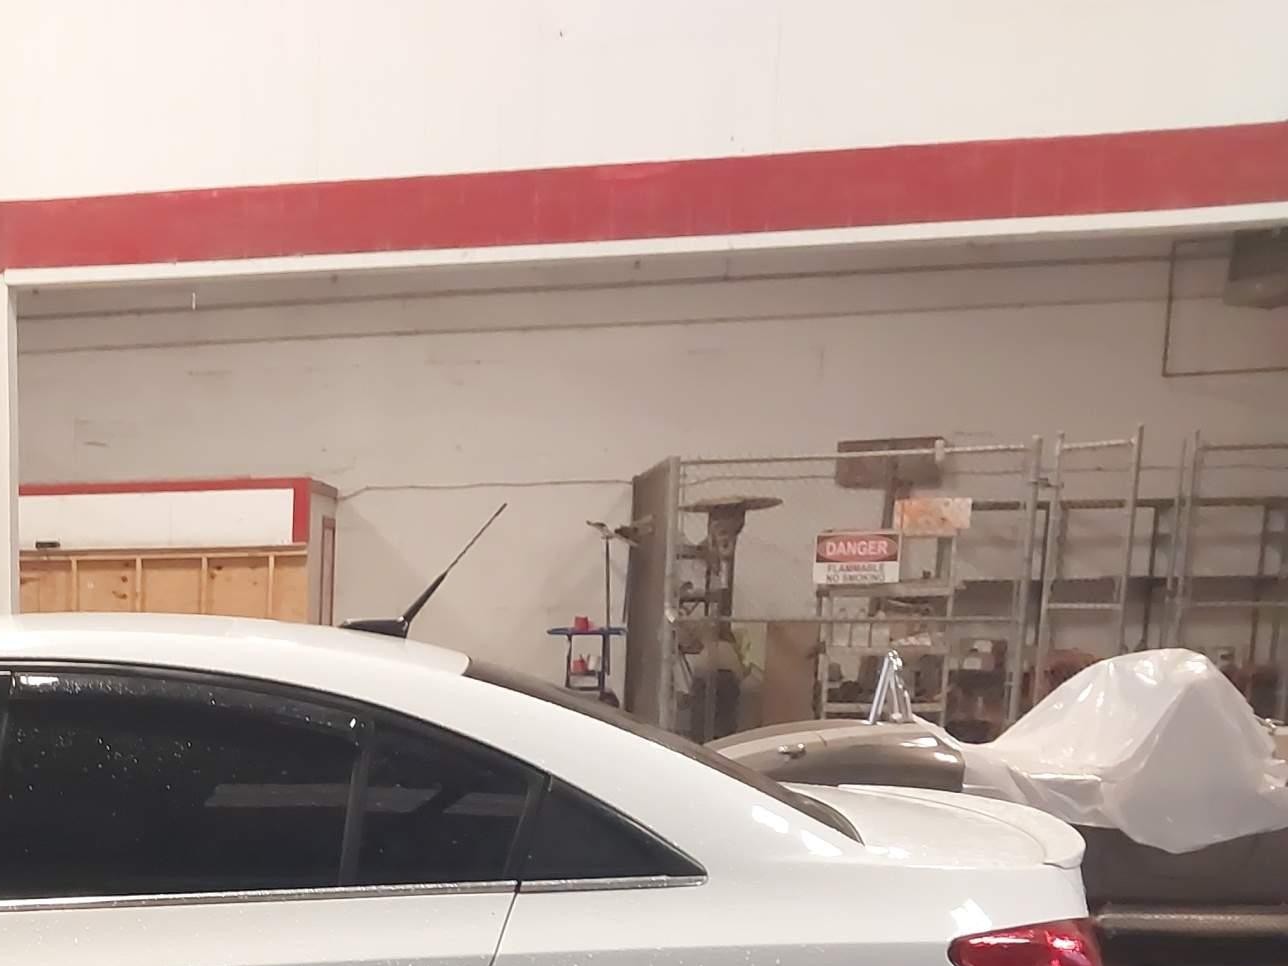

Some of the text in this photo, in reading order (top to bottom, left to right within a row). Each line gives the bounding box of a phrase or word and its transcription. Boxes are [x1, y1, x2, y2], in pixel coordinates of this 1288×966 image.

[825, 540, 888, 556] DANGER
[826, 574, 886, 583] NO SMOKING
